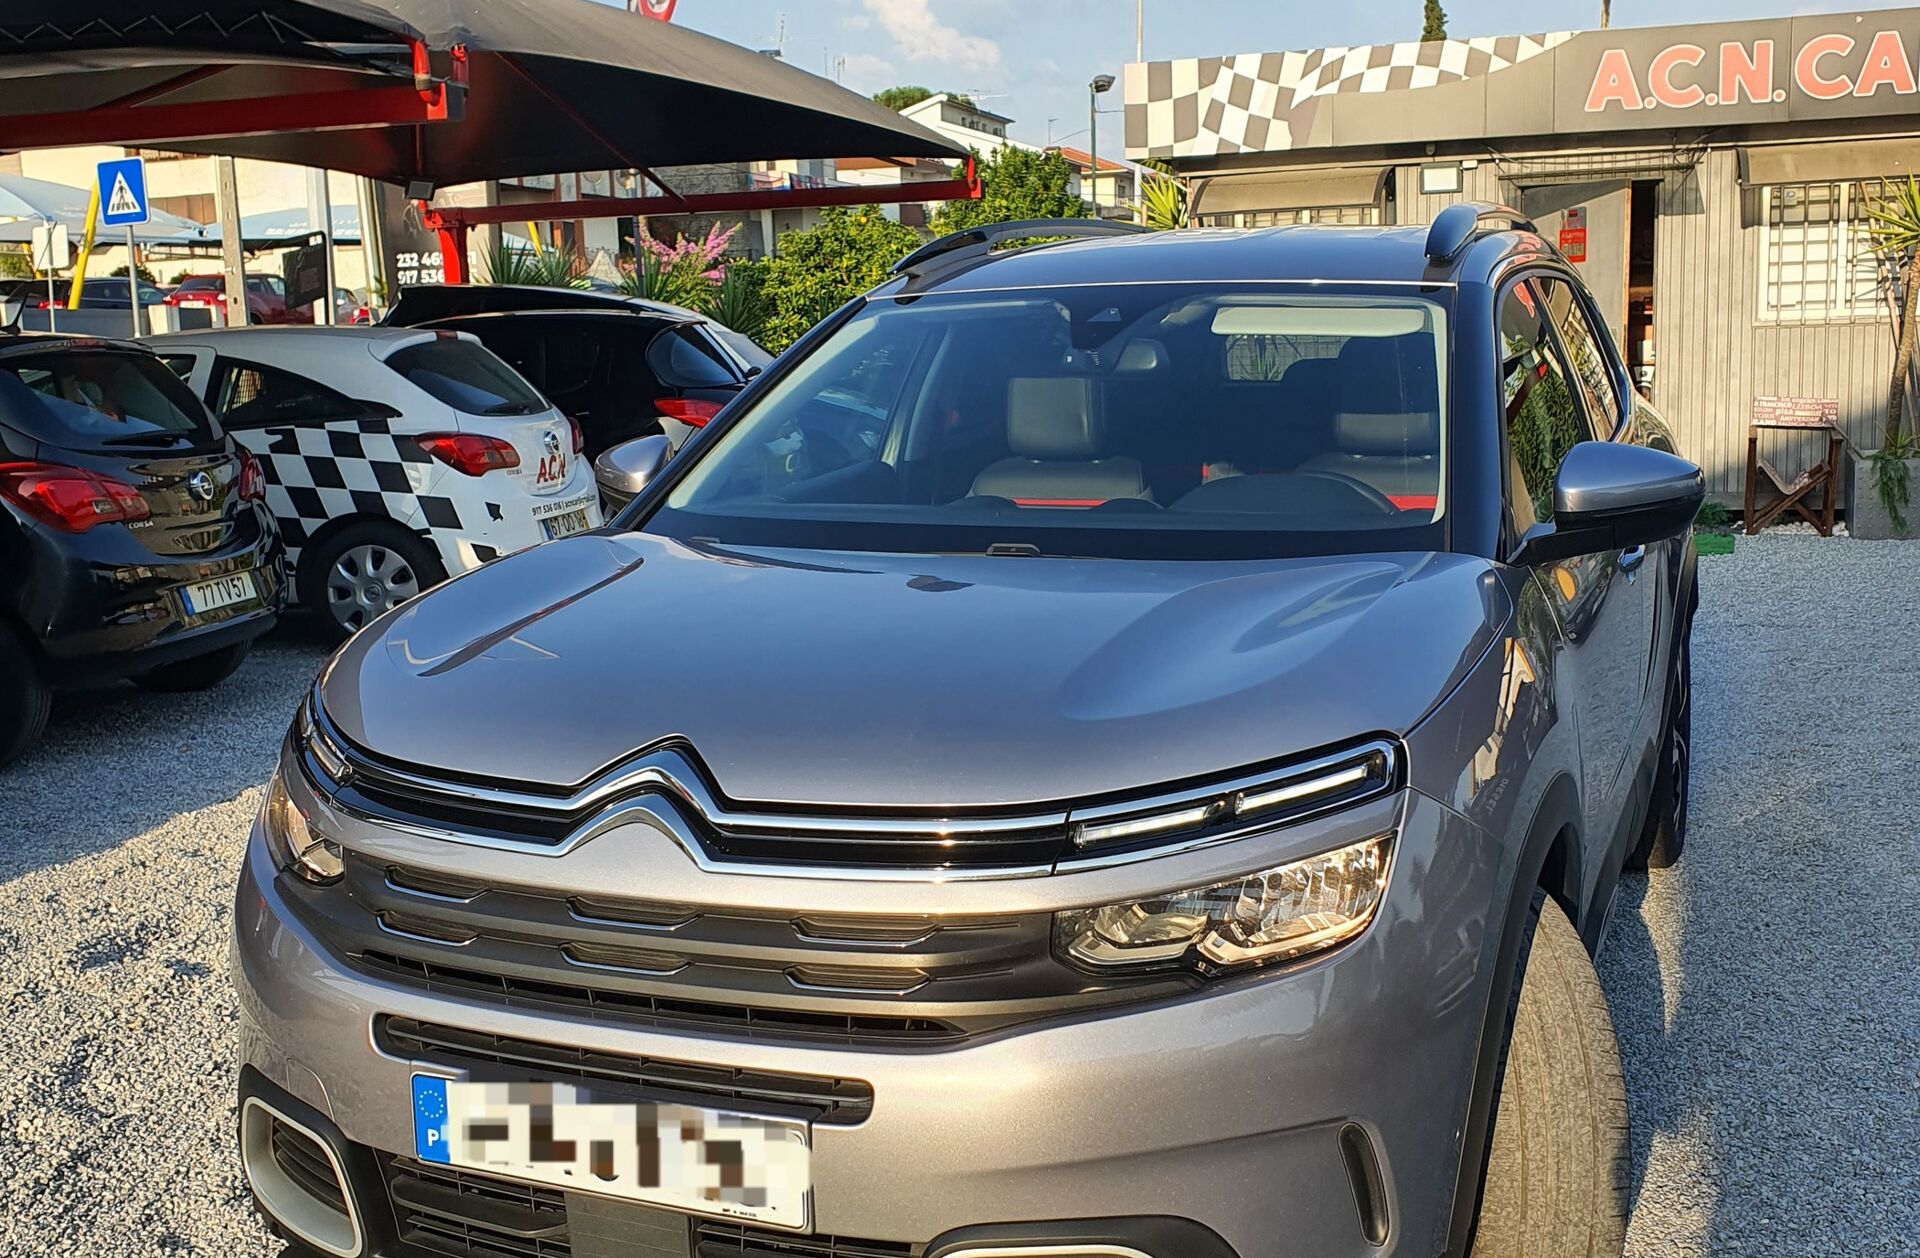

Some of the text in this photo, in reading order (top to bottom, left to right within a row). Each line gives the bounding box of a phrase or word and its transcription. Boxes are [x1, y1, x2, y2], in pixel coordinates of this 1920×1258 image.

[396, 252, 419, 268] 232
[397, 270, 418, 285] 917
[128, 520, 155, 530] CORSA
[427, 1128, 440, 1147] P
